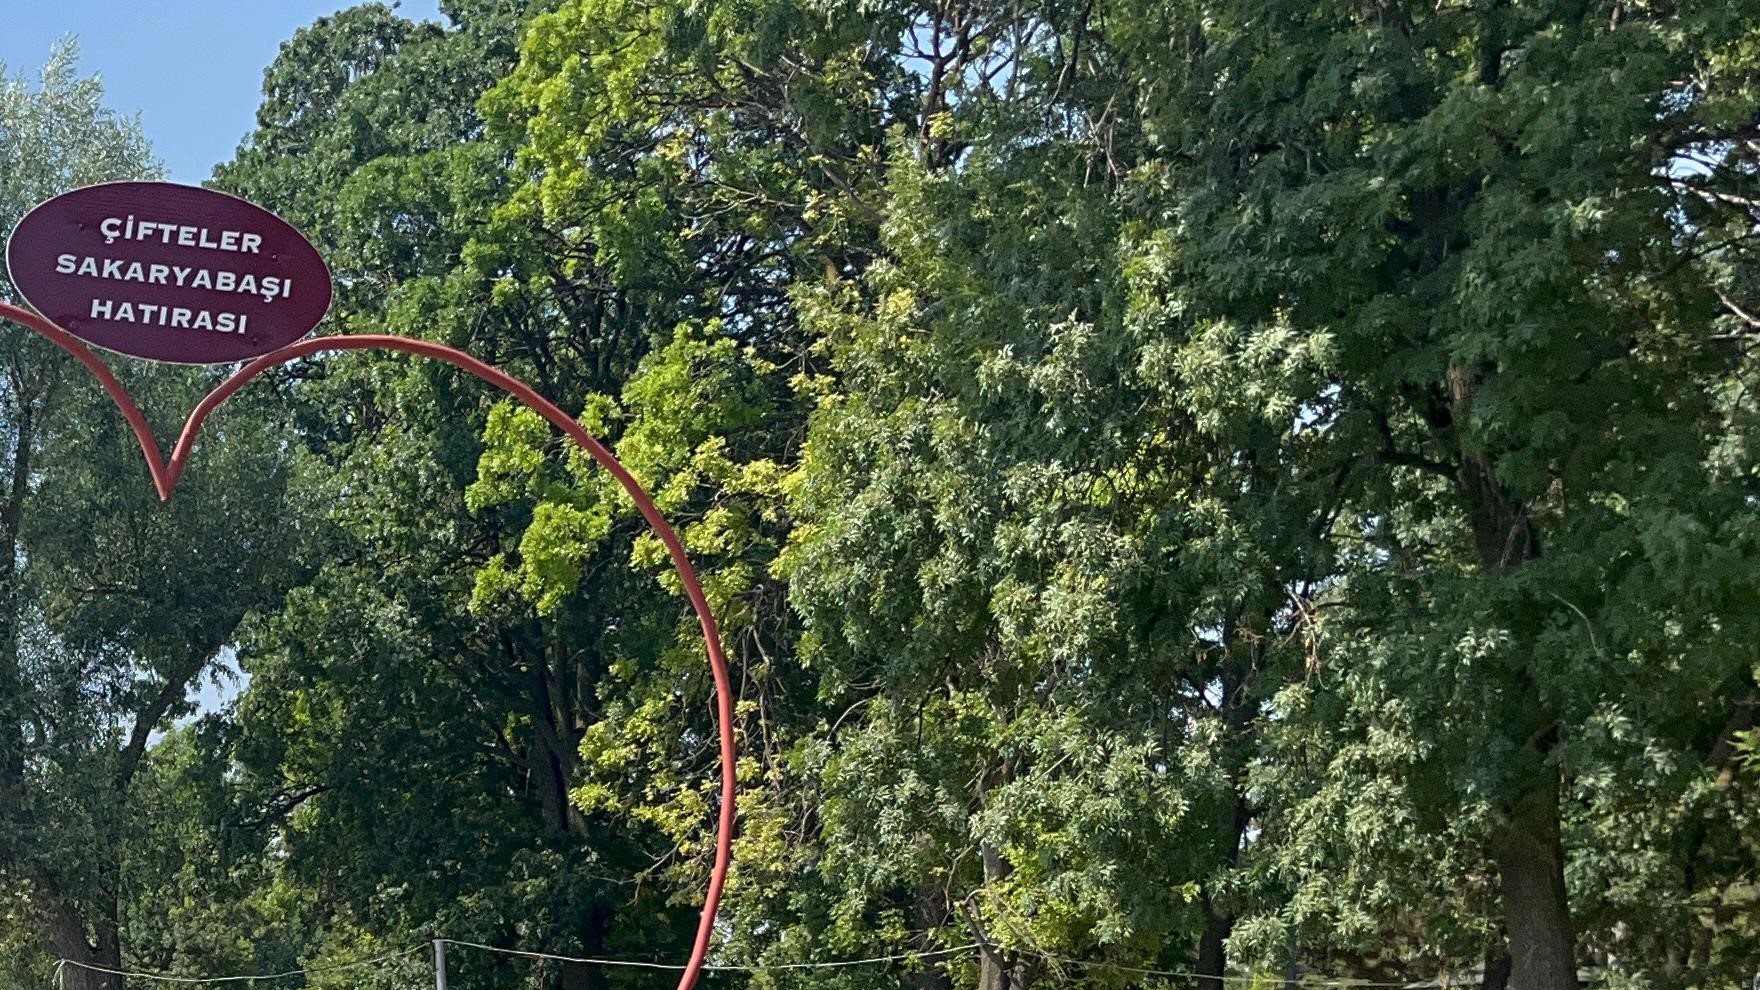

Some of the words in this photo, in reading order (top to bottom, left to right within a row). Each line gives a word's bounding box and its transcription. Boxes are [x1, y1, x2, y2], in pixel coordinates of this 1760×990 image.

[100, 215, 262, 254] ÇİFTELER
[55, 253, 292, 303] SAKARYABAŞI
[90, 299, 247, 334] HATIRASI
